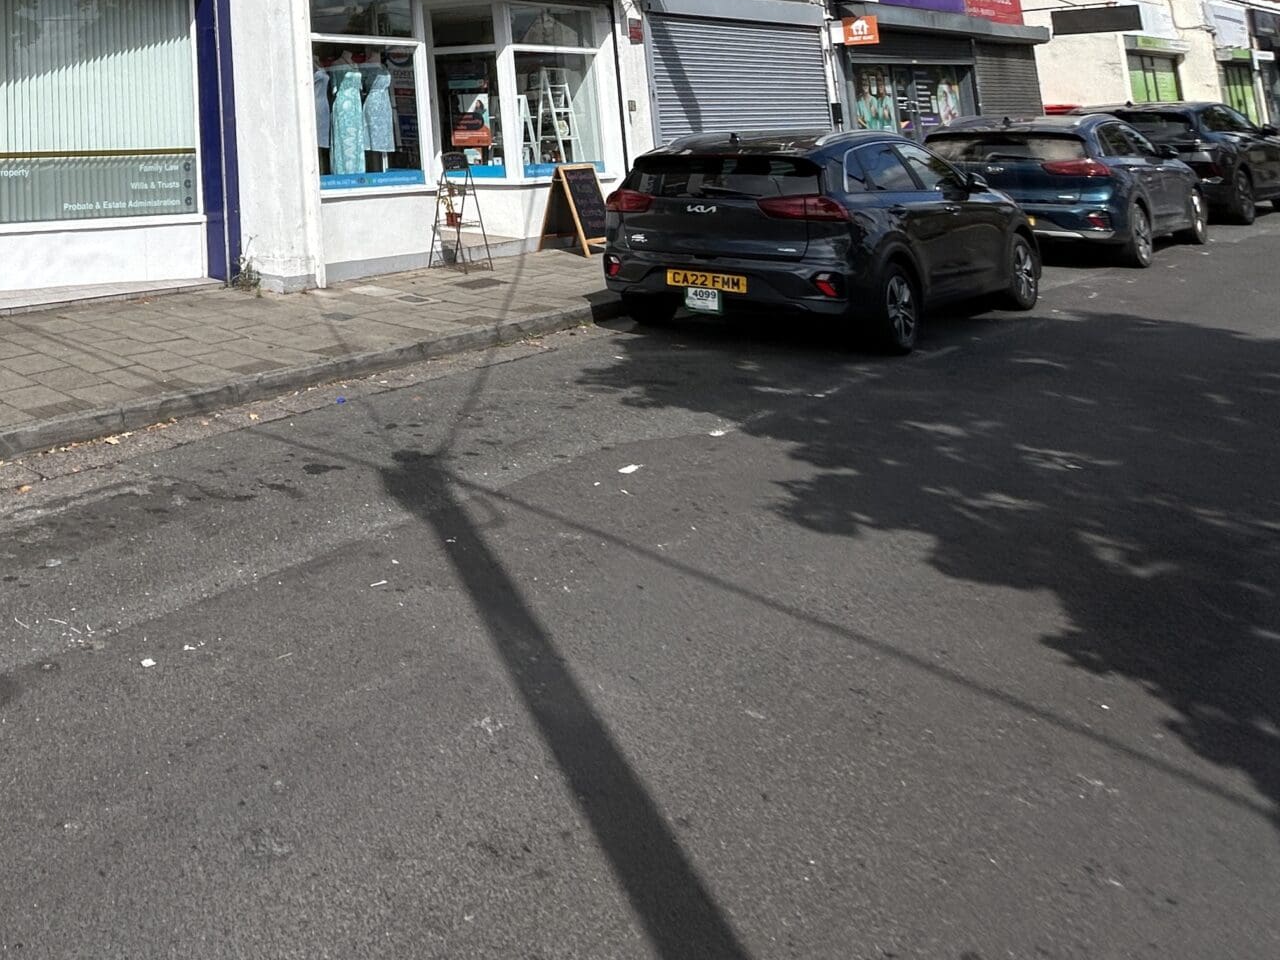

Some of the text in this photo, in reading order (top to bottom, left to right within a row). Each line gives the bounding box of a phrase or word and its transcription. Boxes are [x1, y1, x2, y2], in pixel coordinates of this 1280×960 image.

[139, 163, 163, 173] Family
[157, 181, 180, 189] Trusts
[63, 202, 93, 211] Probate
[102, 201, 126, 209] Estate
[128, 199, 180, 208] Administration
[672, 271, 741, 290] CA22 FMM
[692, 289, 716, 299] 4099
